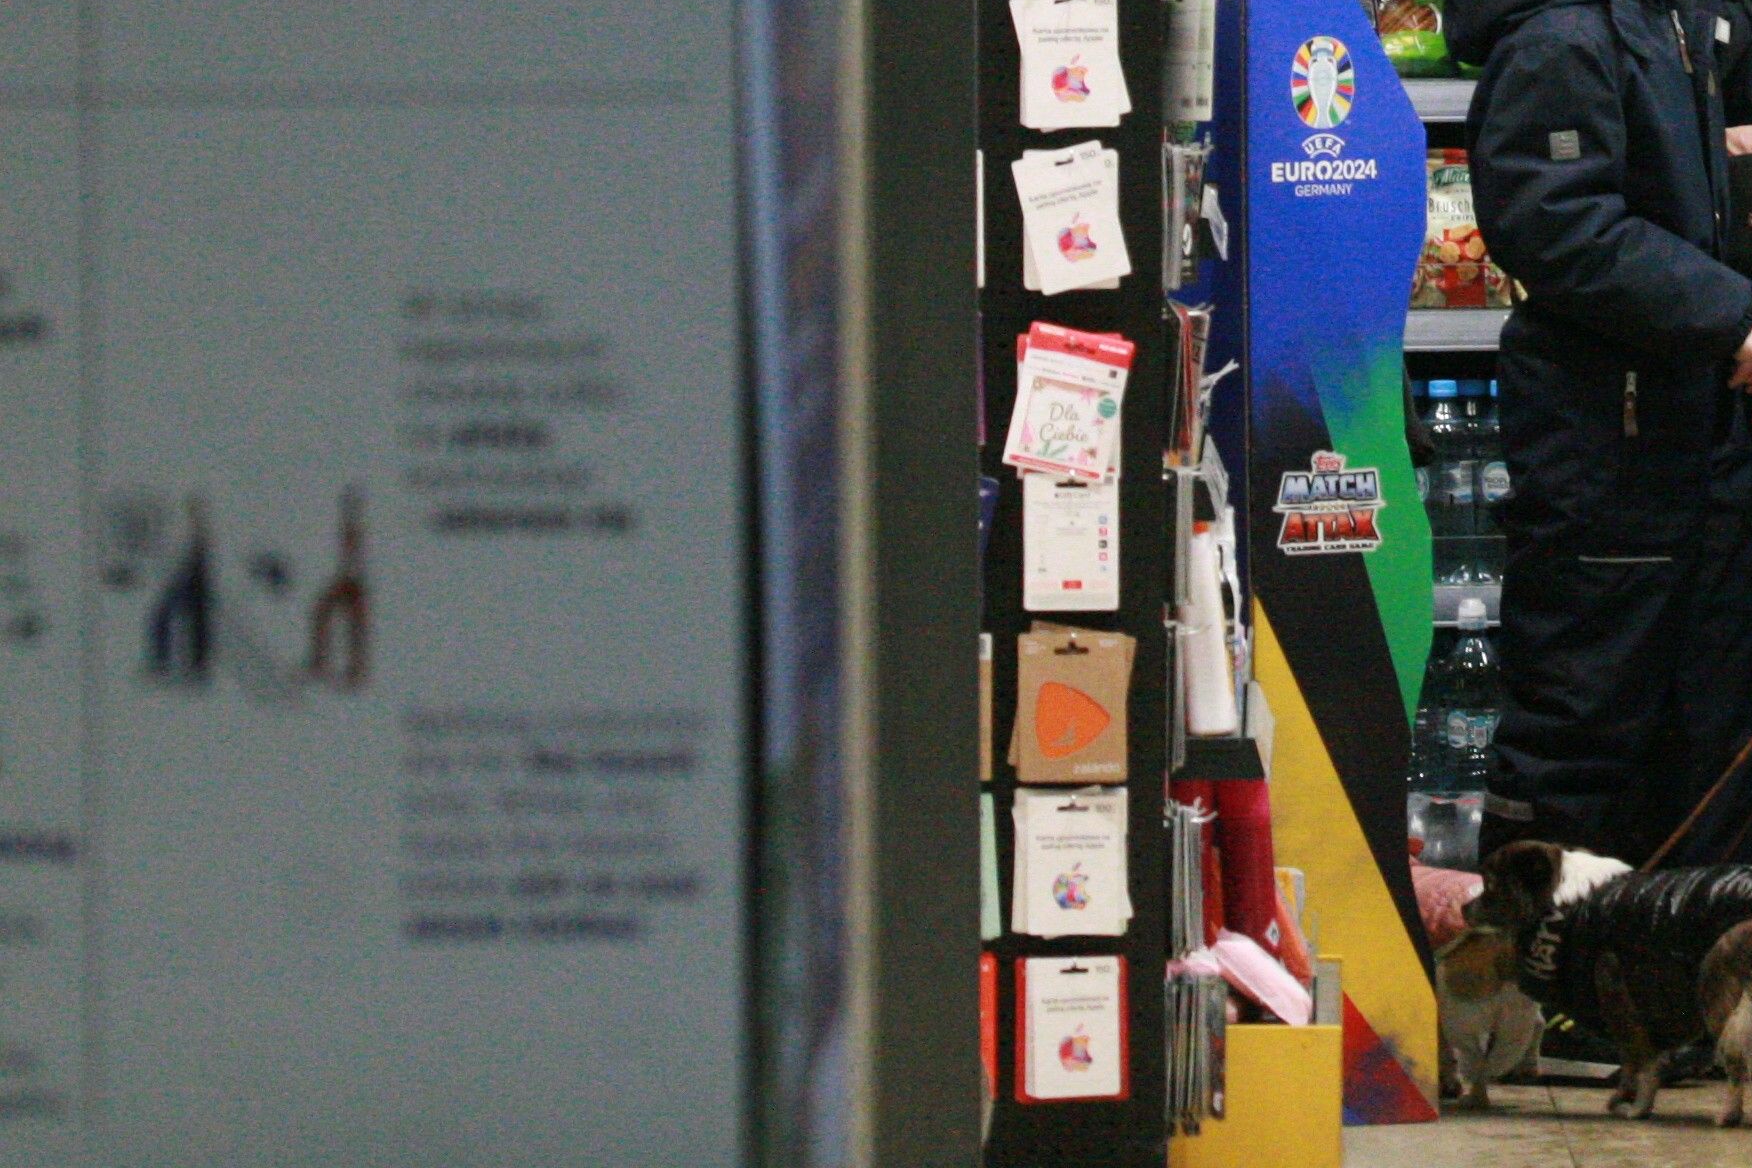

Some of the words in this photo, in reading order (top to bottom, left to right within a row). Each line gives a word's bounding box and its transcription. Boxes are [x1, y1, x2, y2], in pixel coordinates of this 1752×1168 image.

[1303, 137, 1342, 156] UEFA
[1270, 158, 1378, 183] EURO2024
[1294, 182, 1353, 197] GERMANY
[1048, 401, 1081, 422] Dla
[1038, 422, 1090, 444] Ciebie
[1280, 472, 1377, 504] MATCH
[1280, 508, 1380, 544] ATTAX
